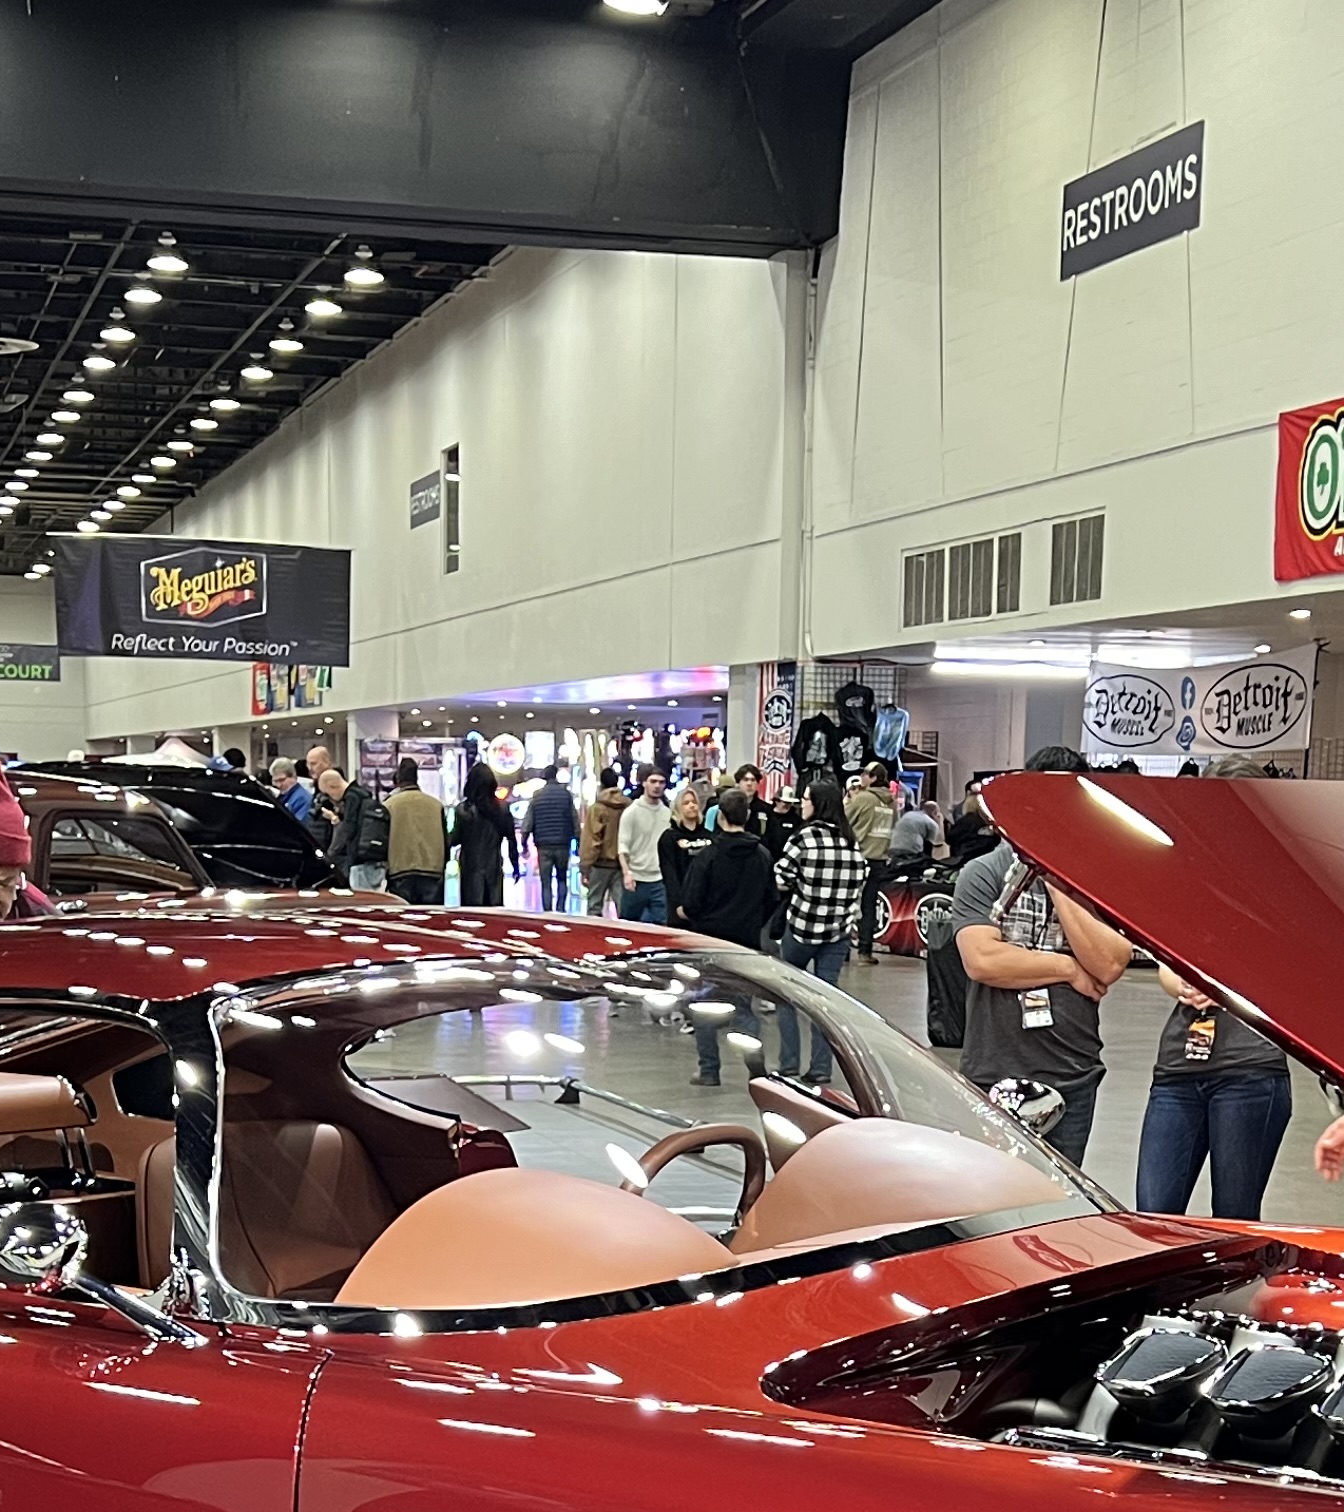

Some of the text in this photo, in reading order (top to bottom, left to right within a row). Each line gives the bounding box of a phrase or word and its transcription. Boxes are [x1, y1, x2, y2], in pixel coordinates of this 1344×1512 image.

[1063, 153, 1198, 252] RESTROOMS
[150, 557, 257, 615] Meguiar's
[112, 633, 176, 654] Reflect
[182, 635, 219, 653] Your
[1094, 681, 1162, 734] Detroit
[1214, 672, 1294, 734] Detroit
[1236, 711, 1273, 738] MUSCLE
